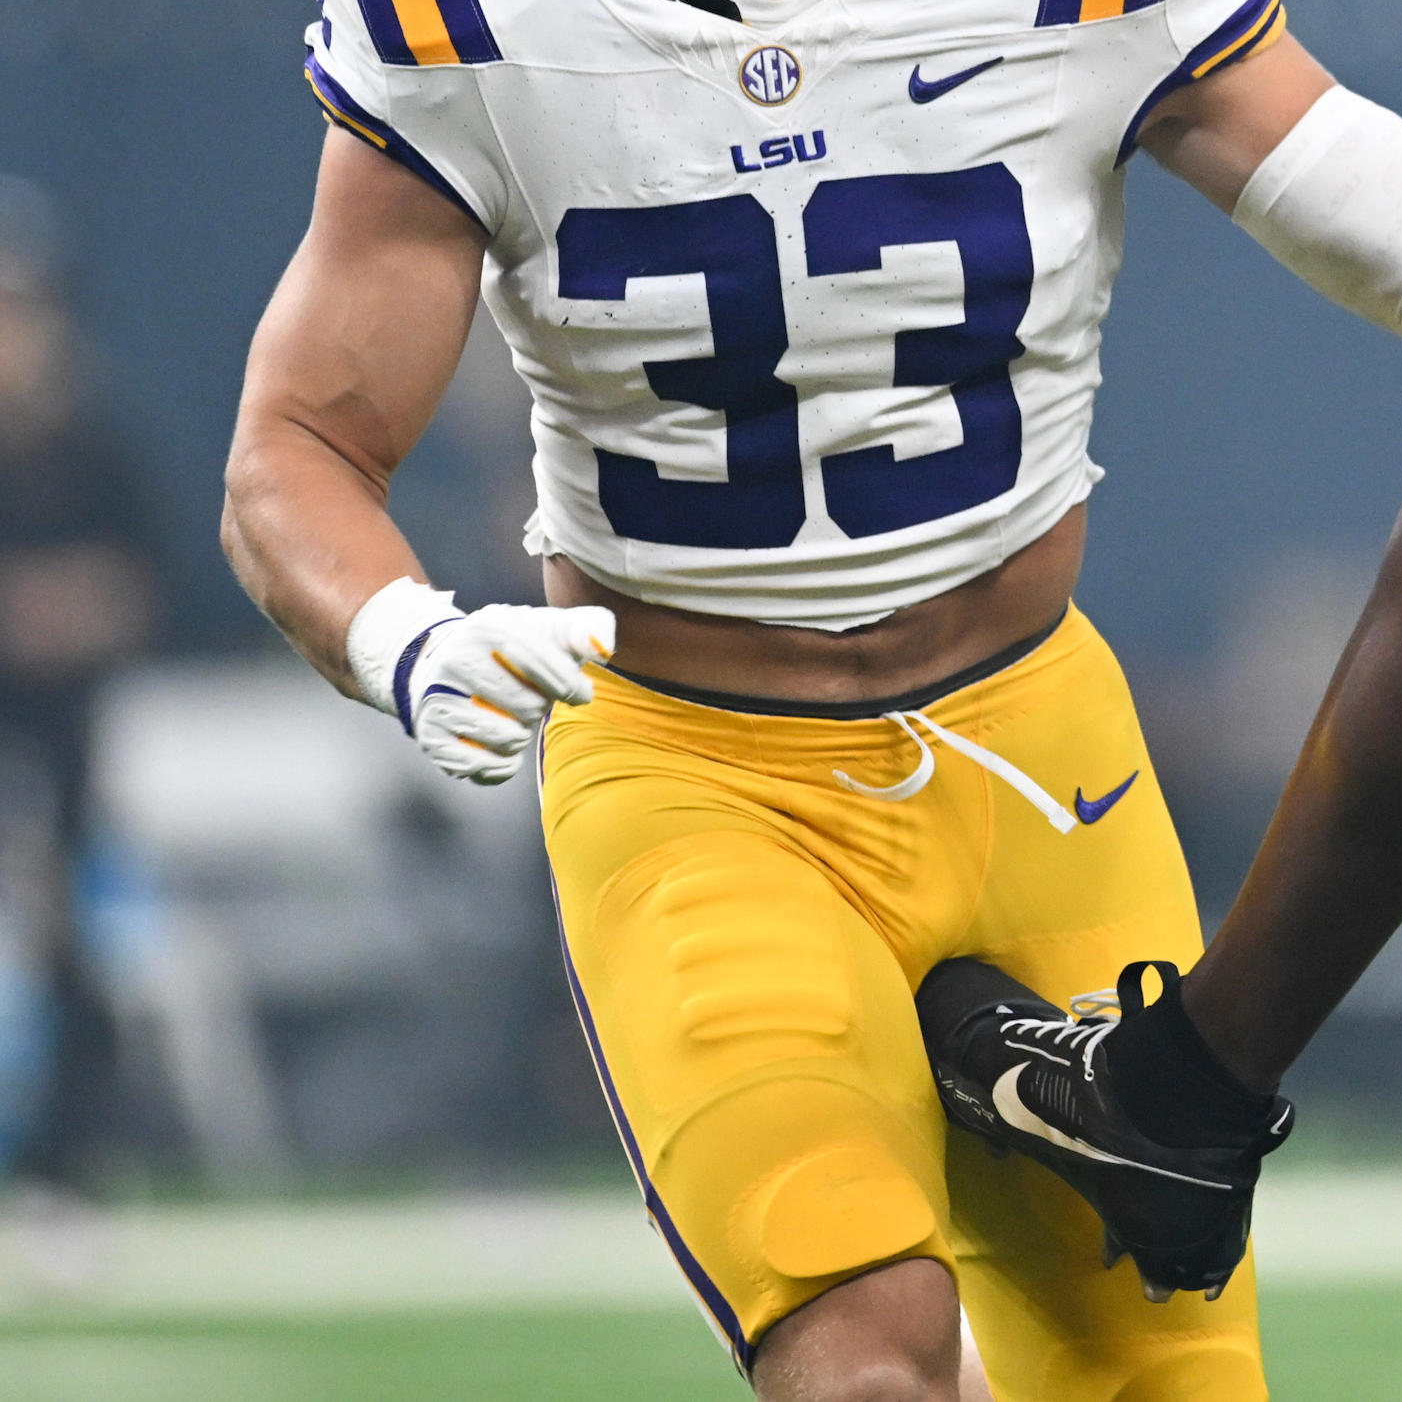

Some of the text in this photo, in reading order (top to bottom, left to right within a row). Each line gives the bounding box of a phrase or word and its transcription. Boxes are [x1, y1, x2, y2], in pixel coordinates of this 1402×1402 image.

[745, 48, 798, 101] SEC
[730, 129, 827, 174] LSU
[555, 161, 1035, 549] 33
